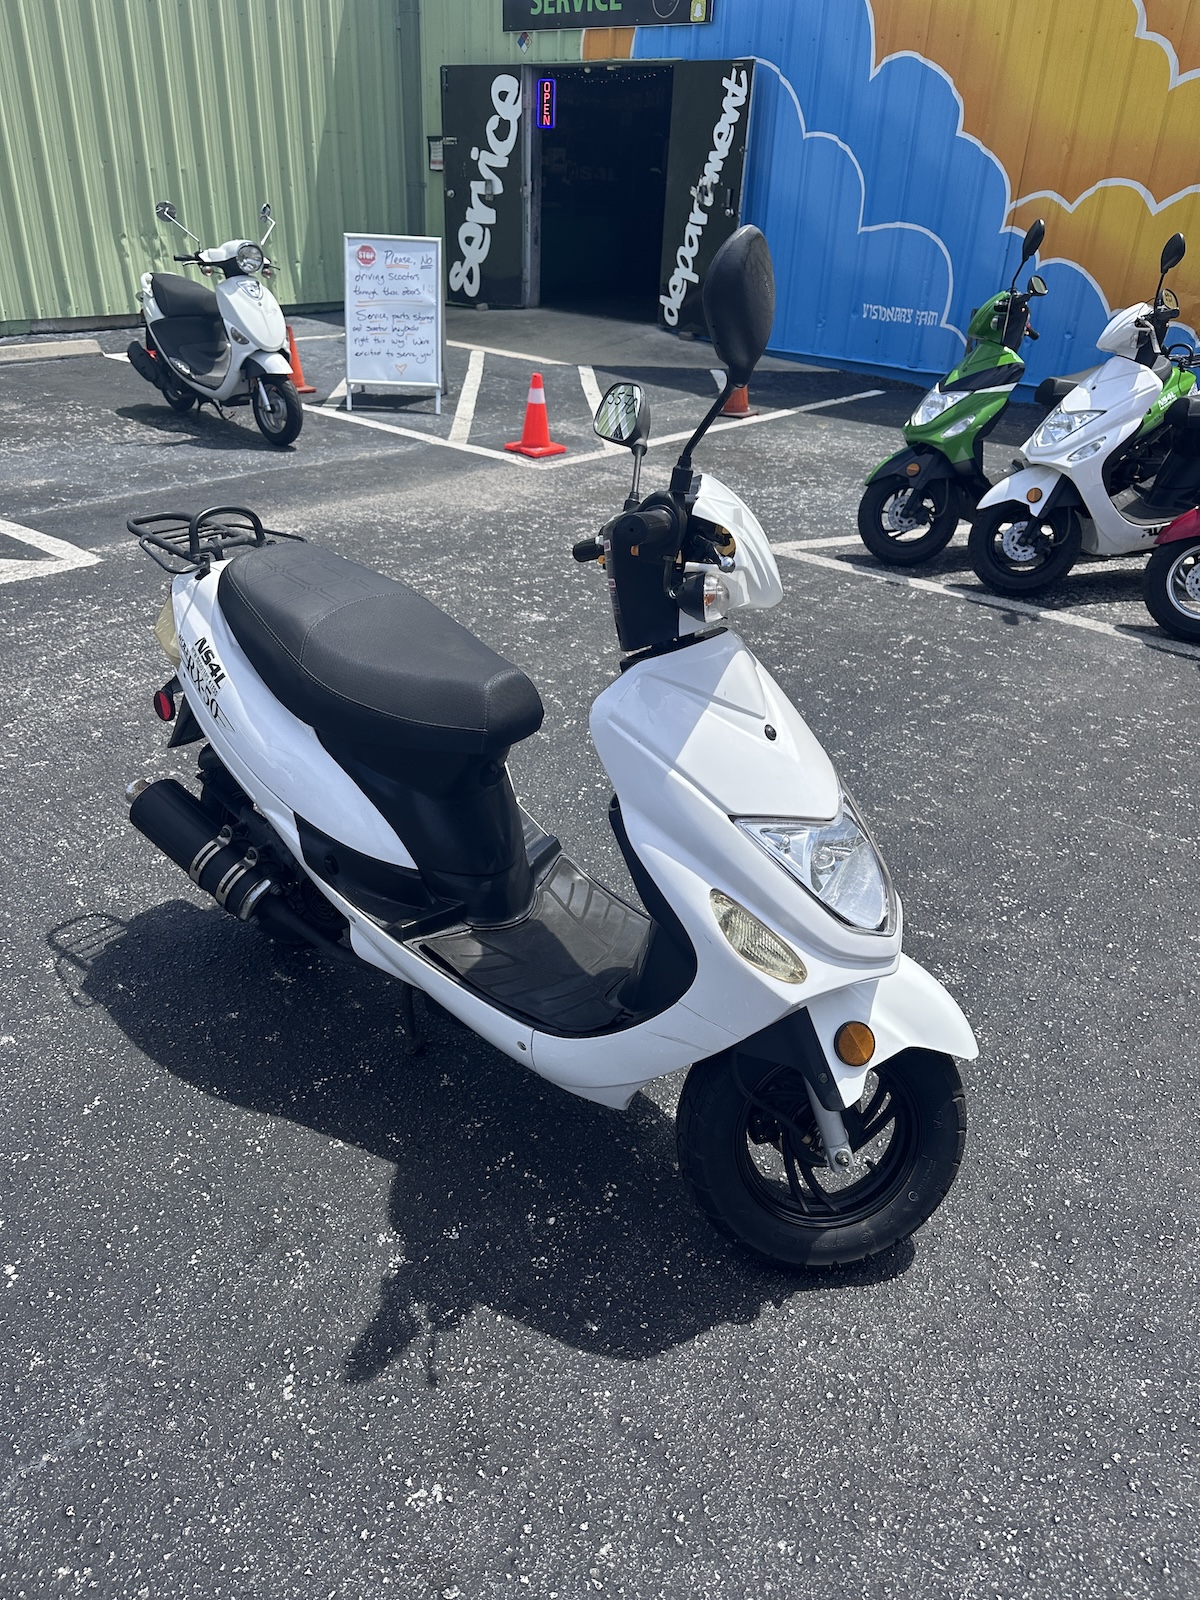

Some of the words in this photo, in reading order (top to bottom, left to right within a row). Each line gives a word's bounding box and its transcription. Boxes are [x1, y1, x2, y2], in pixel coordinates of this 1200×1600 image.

[543, 81, 551, 126] OPEN
[450, 74, 522, 297] service
[660, 68, 747, 326] department
[358, 251, 375, 260] STOP
[421, 254, 433, 265] No
[355, 270, 385, 285] driving
[353, 285, 379, 299] through
[413, 312, 435, 324] storage
[862, 303, 913, 324] VISIONARY
[354, 336, 370, 347] right
[373, 336, 386, 345] this
[355, 349, 382, 357] excited
[386, 349, 394, 358] to
[195, 637, 226, 690] NS4L
[187, 655, 220, 719] RX-50
